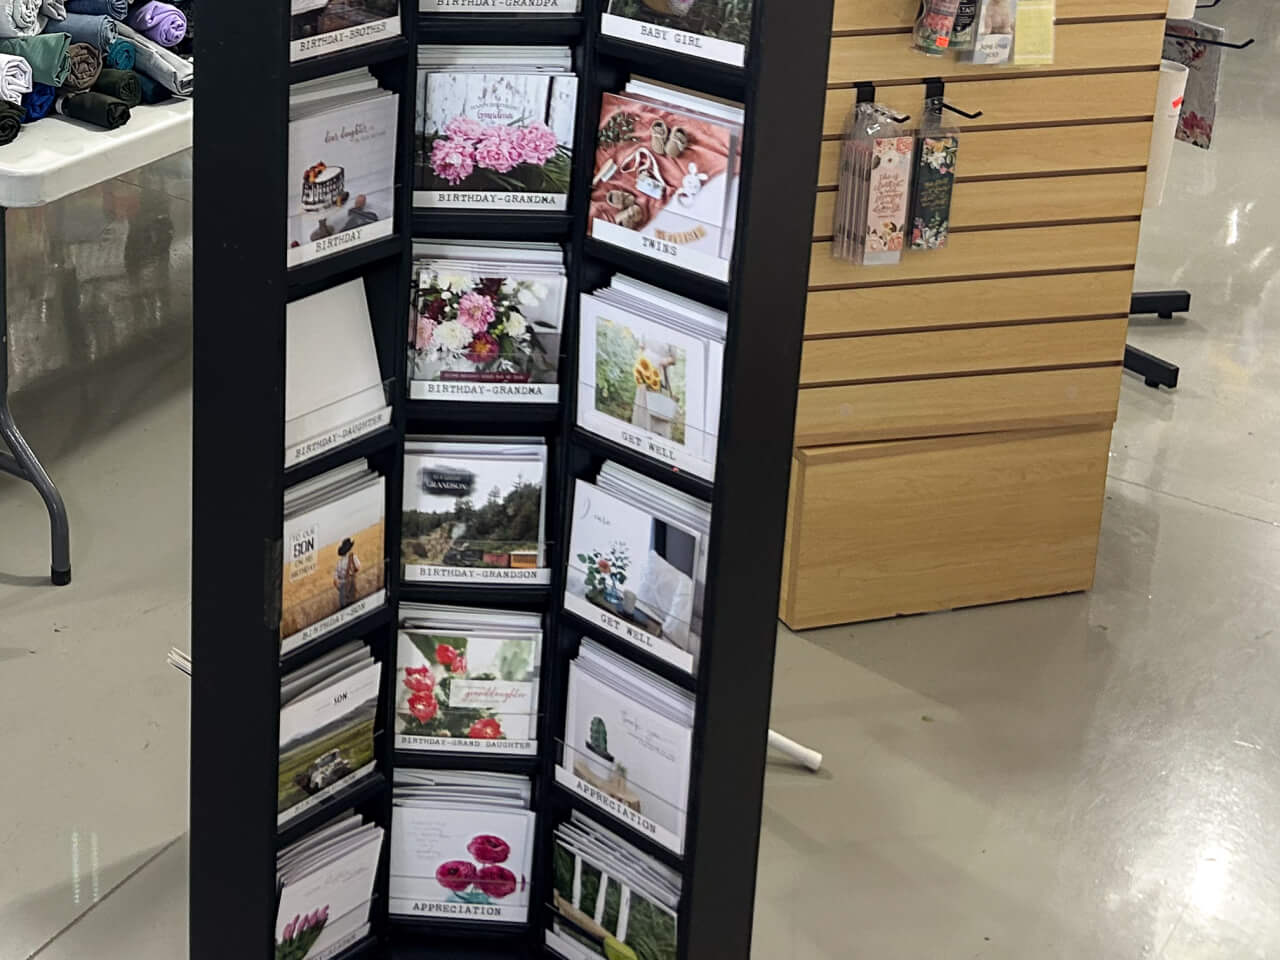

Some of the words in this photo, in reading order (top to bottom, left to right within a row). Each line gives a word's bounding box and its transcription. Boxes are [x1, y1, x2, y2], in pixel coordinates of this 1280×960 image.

[300, 22, 387, 52] BIRTHDAY-BROTHER
[640, 25, 667, 41] BABY
[674, 34, 703, 49] GIRL
[438, 194, 556, 205] BIRTHDAY-GRANDMA
[315, 230, 362, 253] BIRTHDAY
[641, 236, 678, 256] TWINS
[428, 383, 543, 395] BIRTHDAY-GRANDMA
[295, 414, 384, 458] BIRTHDAY-DAUGHTER
[621, 431, 642, 447] GET
[648, 442, 677, 461] WELL
[425, 479, 467, 490] GRANDSON
[293, 538, 315, 559] SON
[420, 567, 537, 580] BIRTHDAY-GRANDSON
[302, 602, 367, 640] BIRTHDAY-SON
[600, 614, 621, 630] GET
[627, 628, 654, 647] WELL
[401, 737, 480, 748] BIRTHDAY-GRAND
[485, 740, 532, 750] DAUGHTER
[575, 780, 657, 834] APPRECIATION
[412, 902, 502, 916] APPRECIATION
